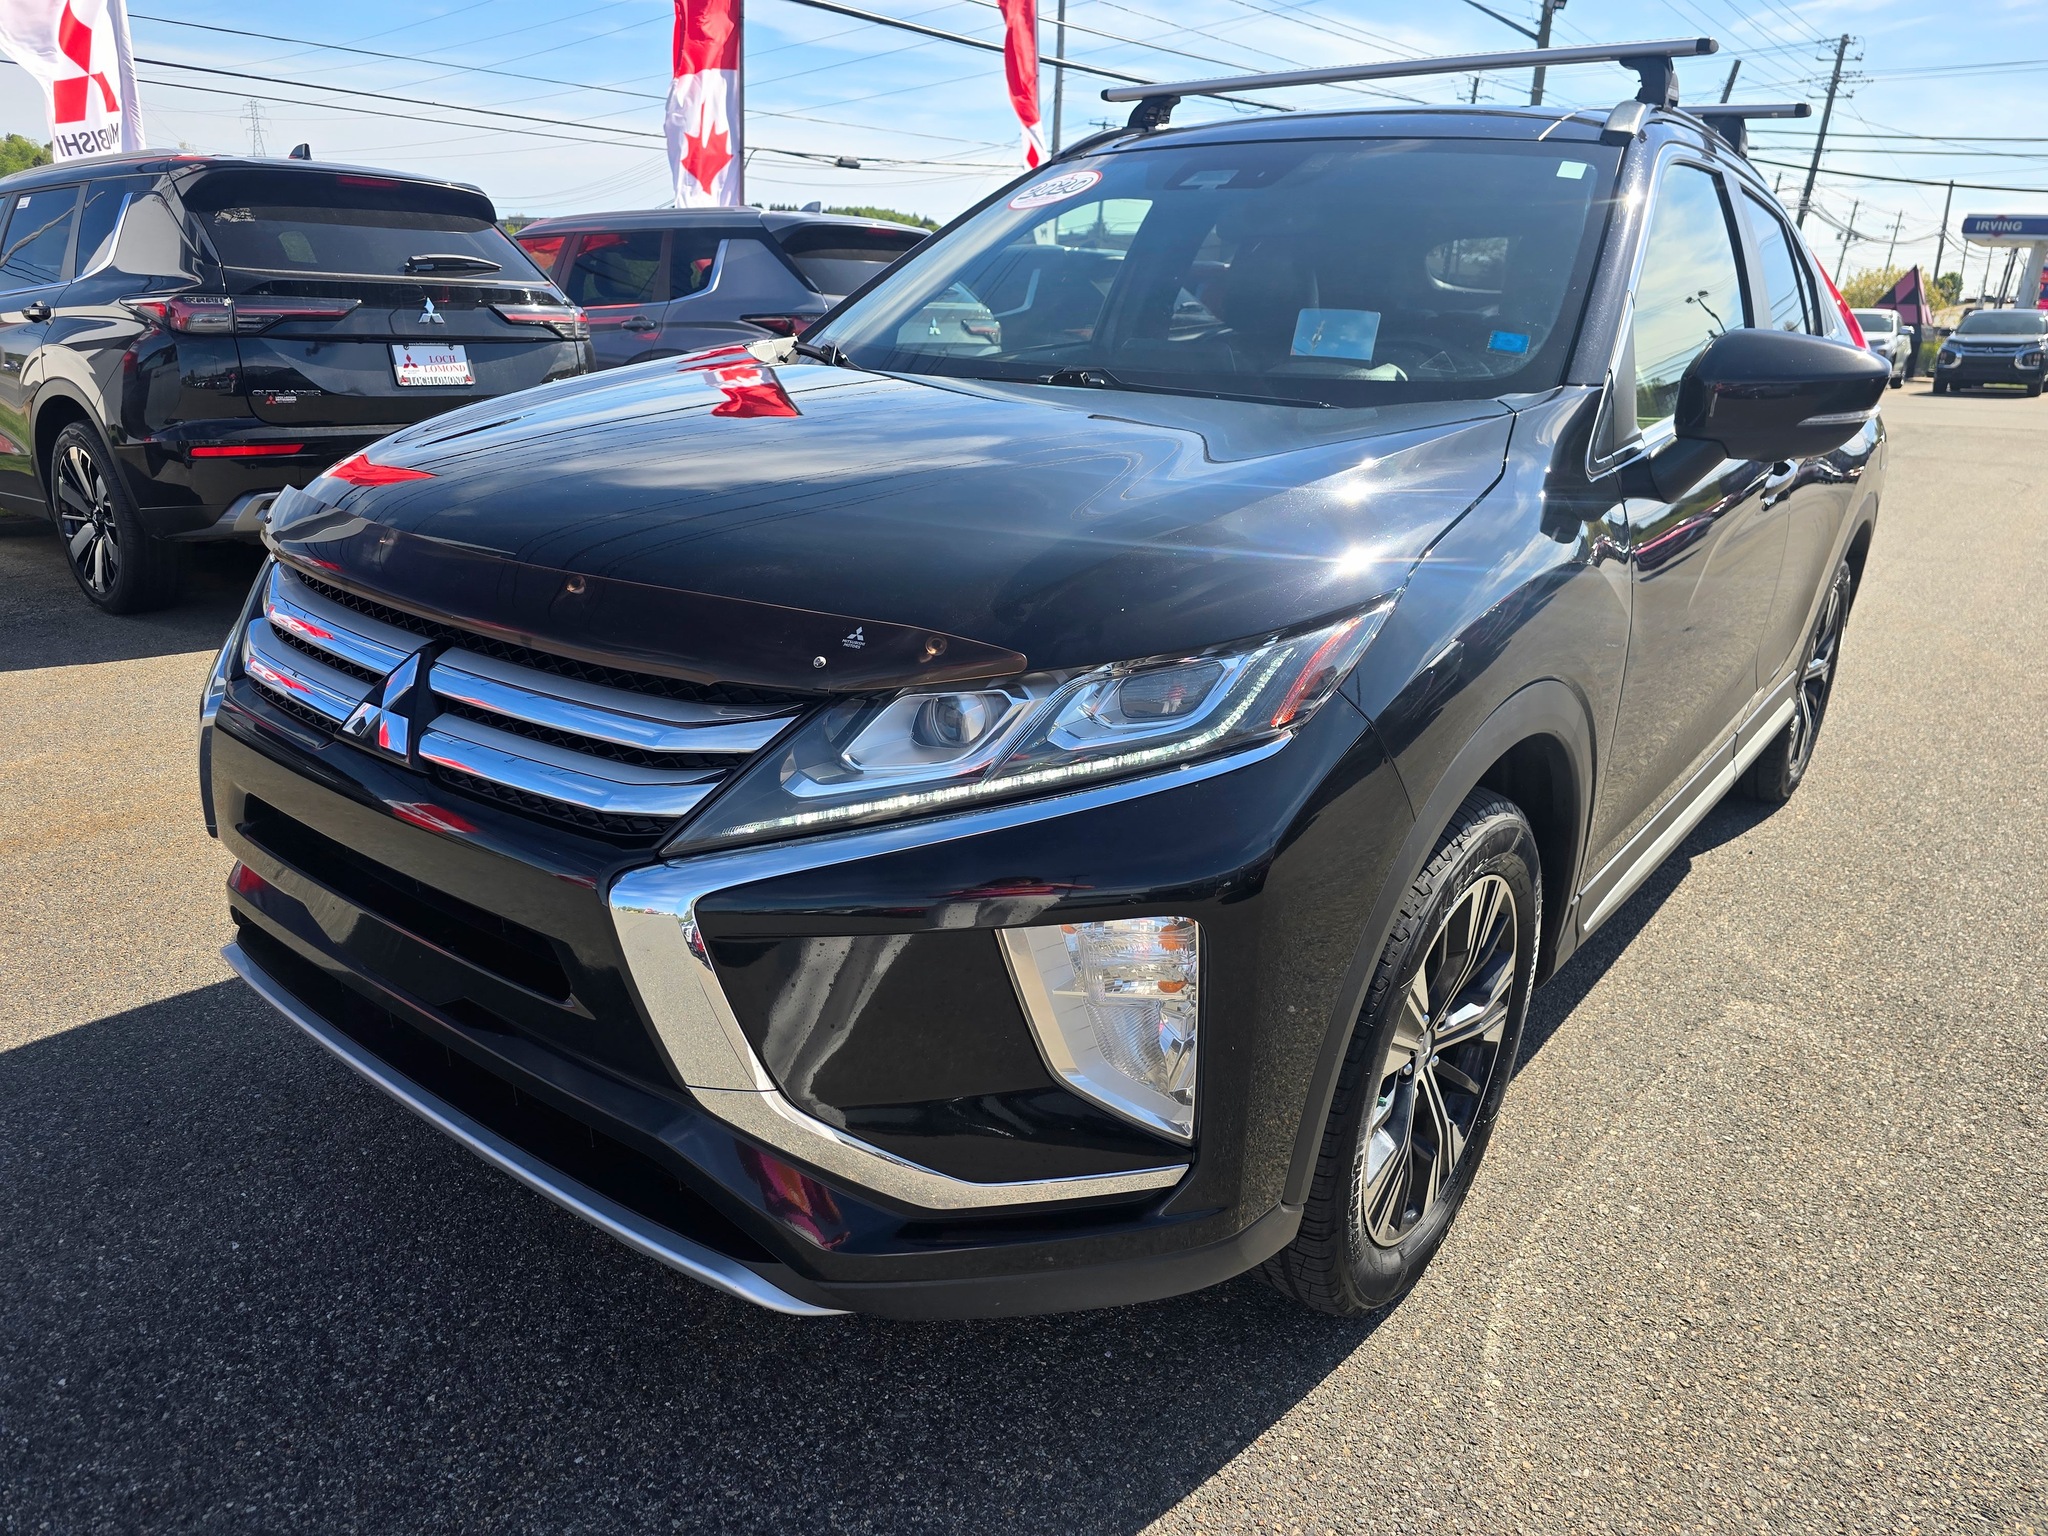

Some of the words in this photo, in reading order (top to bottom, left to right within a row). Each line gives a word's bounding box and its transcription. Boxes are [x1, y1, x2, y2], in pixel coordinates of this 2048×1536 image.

[1975, 220, 2023, 232] IRVING
[428, 355, 456, 364] LOCH
[423, 364, 466, 373] LOMOND
[251, 389, 322, 397] OUTLANDER
